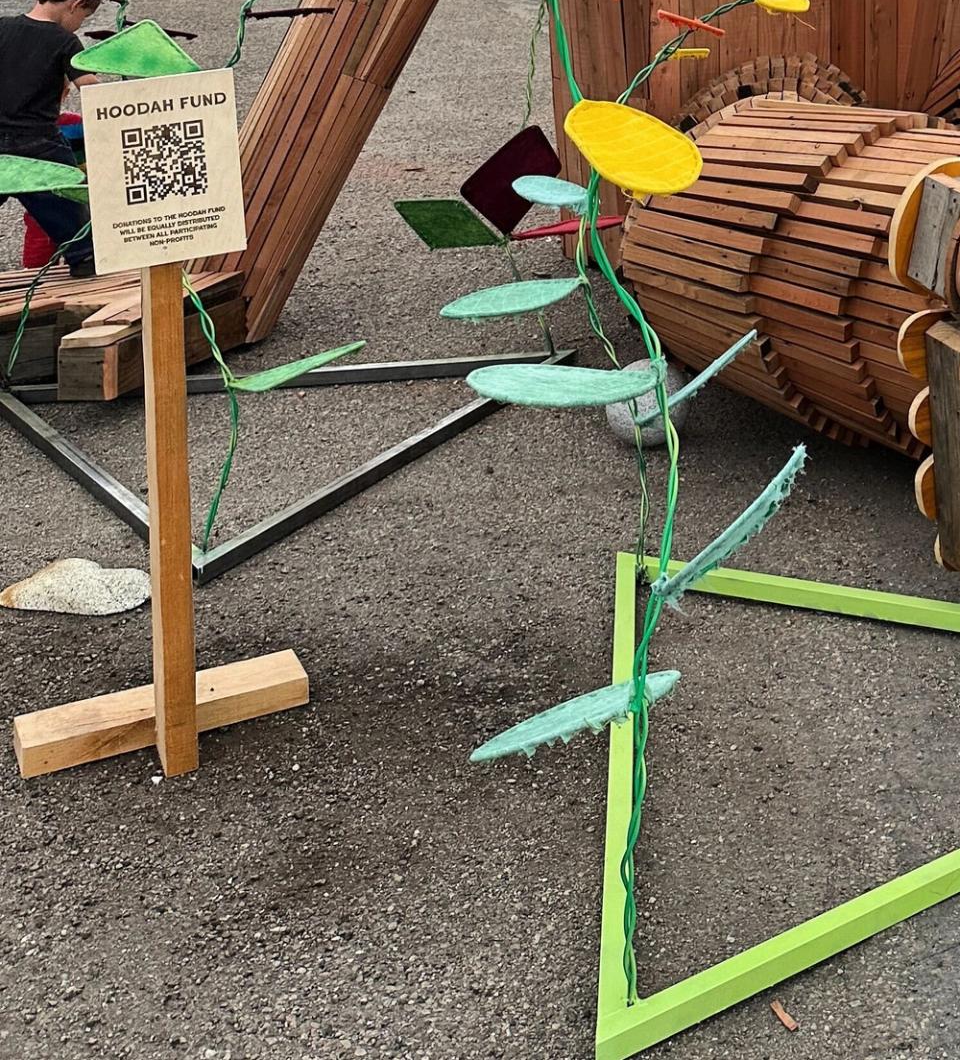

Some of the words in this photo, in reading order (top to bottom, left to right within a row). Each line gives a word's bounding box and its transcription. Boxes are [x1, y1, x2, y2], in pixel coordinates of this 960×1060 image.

[96, 99, 174, 121] HOODAH
[180, 92, 227, 110] FUND
[112, 217, 152, 229] DONATIONS
[164, 213, 177, 221] THE
[178, 209, 207, 218] HOODAH
[207, 205, 226, 214] FUND
[119, 228, 136, 236] WILL
[147, 221, 176, 232] EQUALLY
[177, 214, 221, 227] DISTRIBUTED
[123, 233, 155, 244] BETWEEN
[155, 230, 169, 238] ALL
[169, 222, 218, 235] PARTICIPATING
[149, 234, 194, 247] NON-PROFITS
